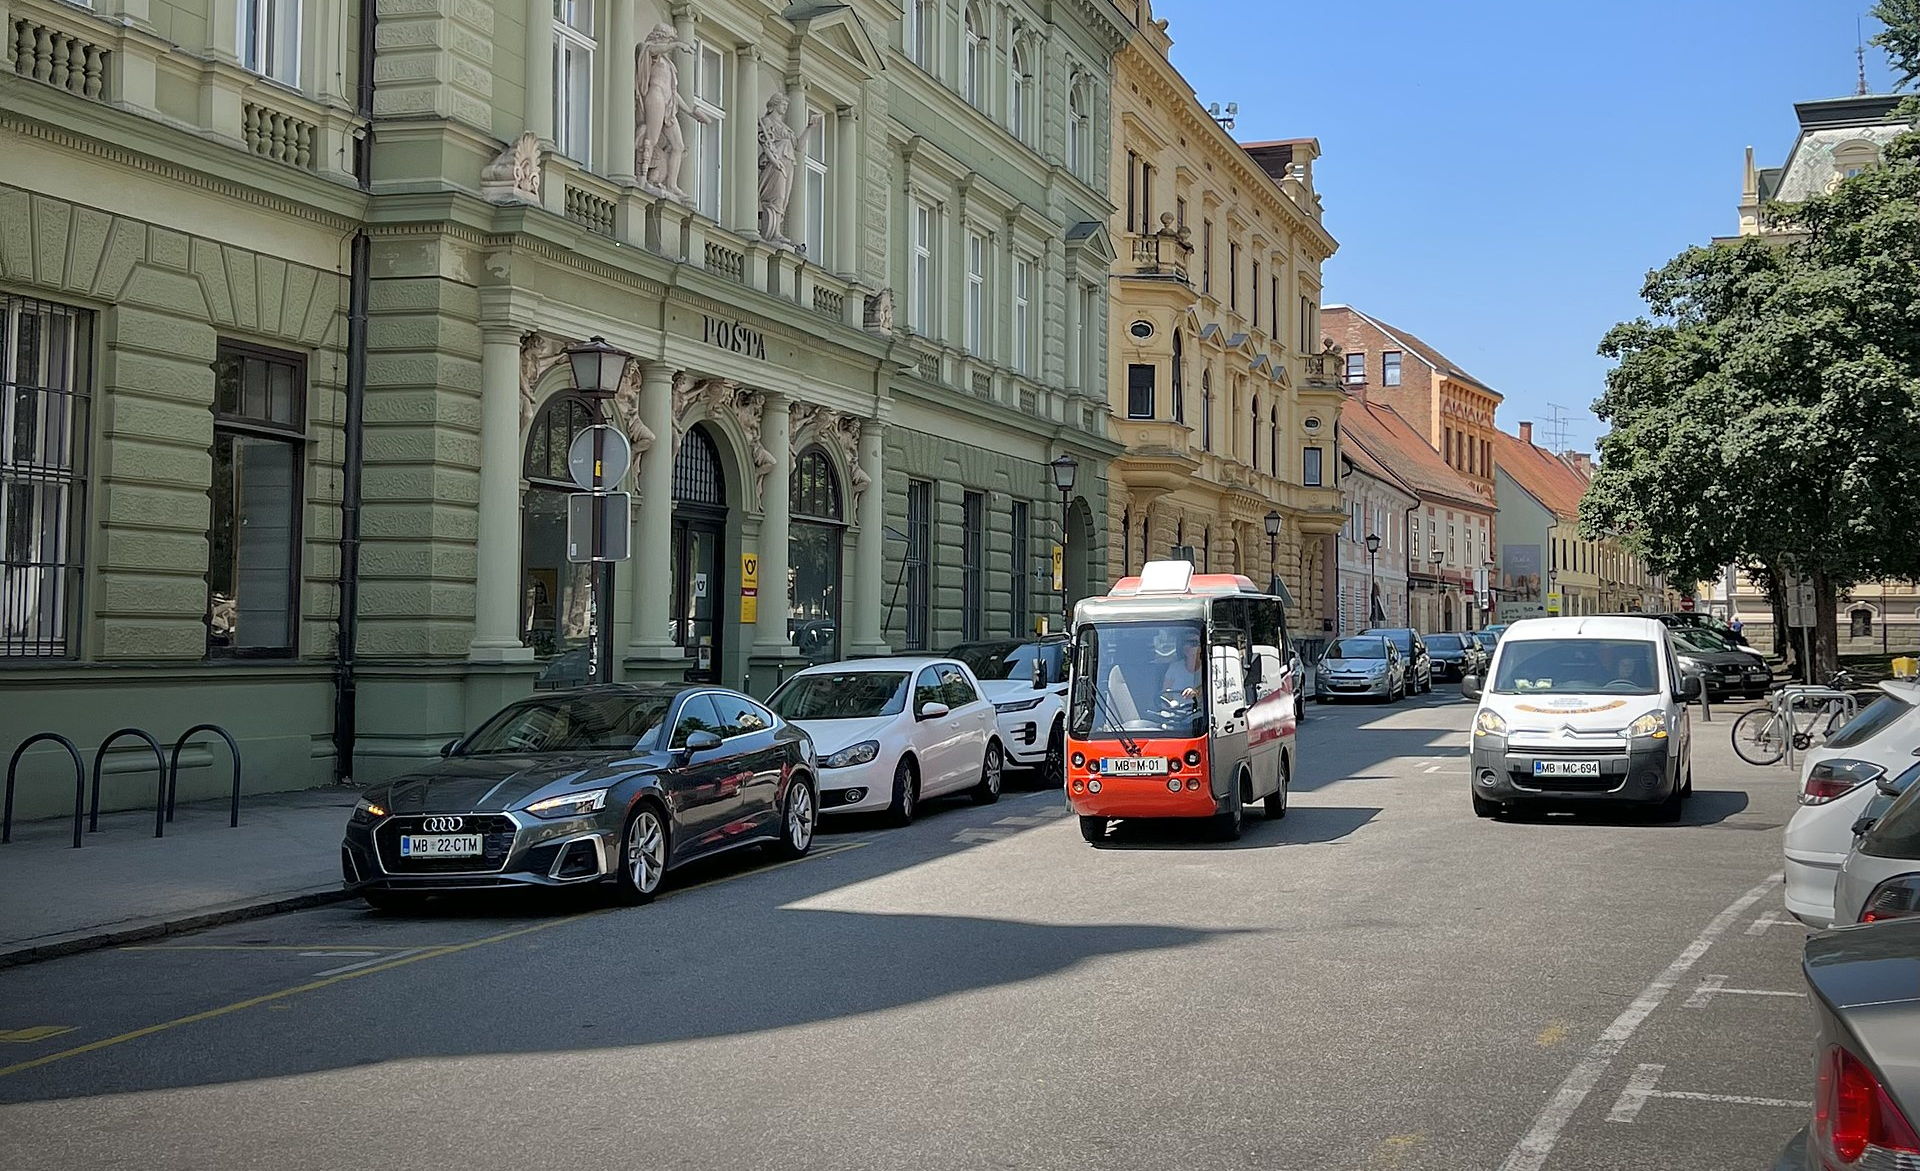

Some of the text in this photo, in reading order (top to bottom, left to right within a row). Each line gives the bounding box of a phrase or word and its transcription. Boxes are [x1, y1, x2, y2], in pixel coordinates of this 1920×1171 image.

[703, 315, 767, 361] POŠTA
[1562, 763, 1597, 774] MC-694
[437, 837, 478, 852] 22-CTM
